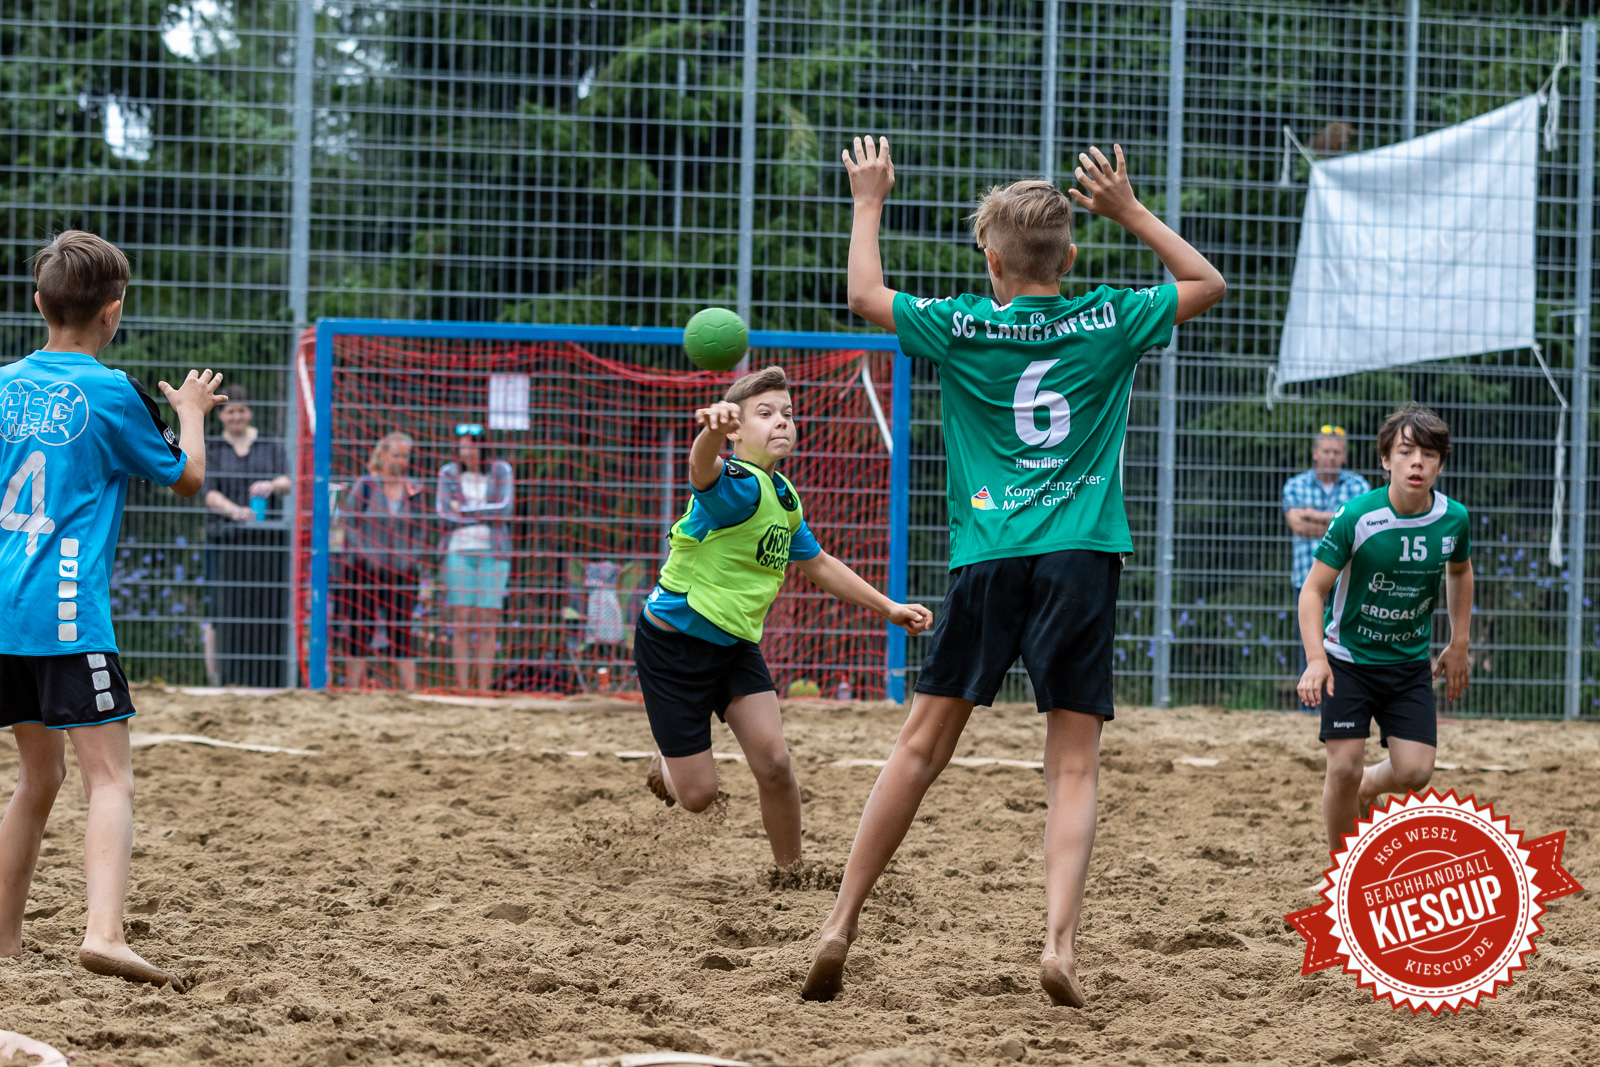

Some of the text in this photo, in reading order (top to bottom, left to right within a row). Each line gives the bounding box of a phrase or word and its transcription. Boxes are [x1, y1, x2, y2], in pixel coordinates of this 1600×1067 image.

[952, 302, 1117, 342] SG LANGENFELD
[2, 389, 75, 427] HSG
[1012, 358, 1071, 449] 6
[8, 420, 57, 437] WESEL
[0, 450, 56, 557] 4
[1366, 518, 1389, 527] Kempa
[1399, 535, 1428, 562] 15
[760, 554, 787, 571] SPOR
[1361, 603, 1416, 620] ERDGAS
[1333, 721, 1355, 730] Kempa
